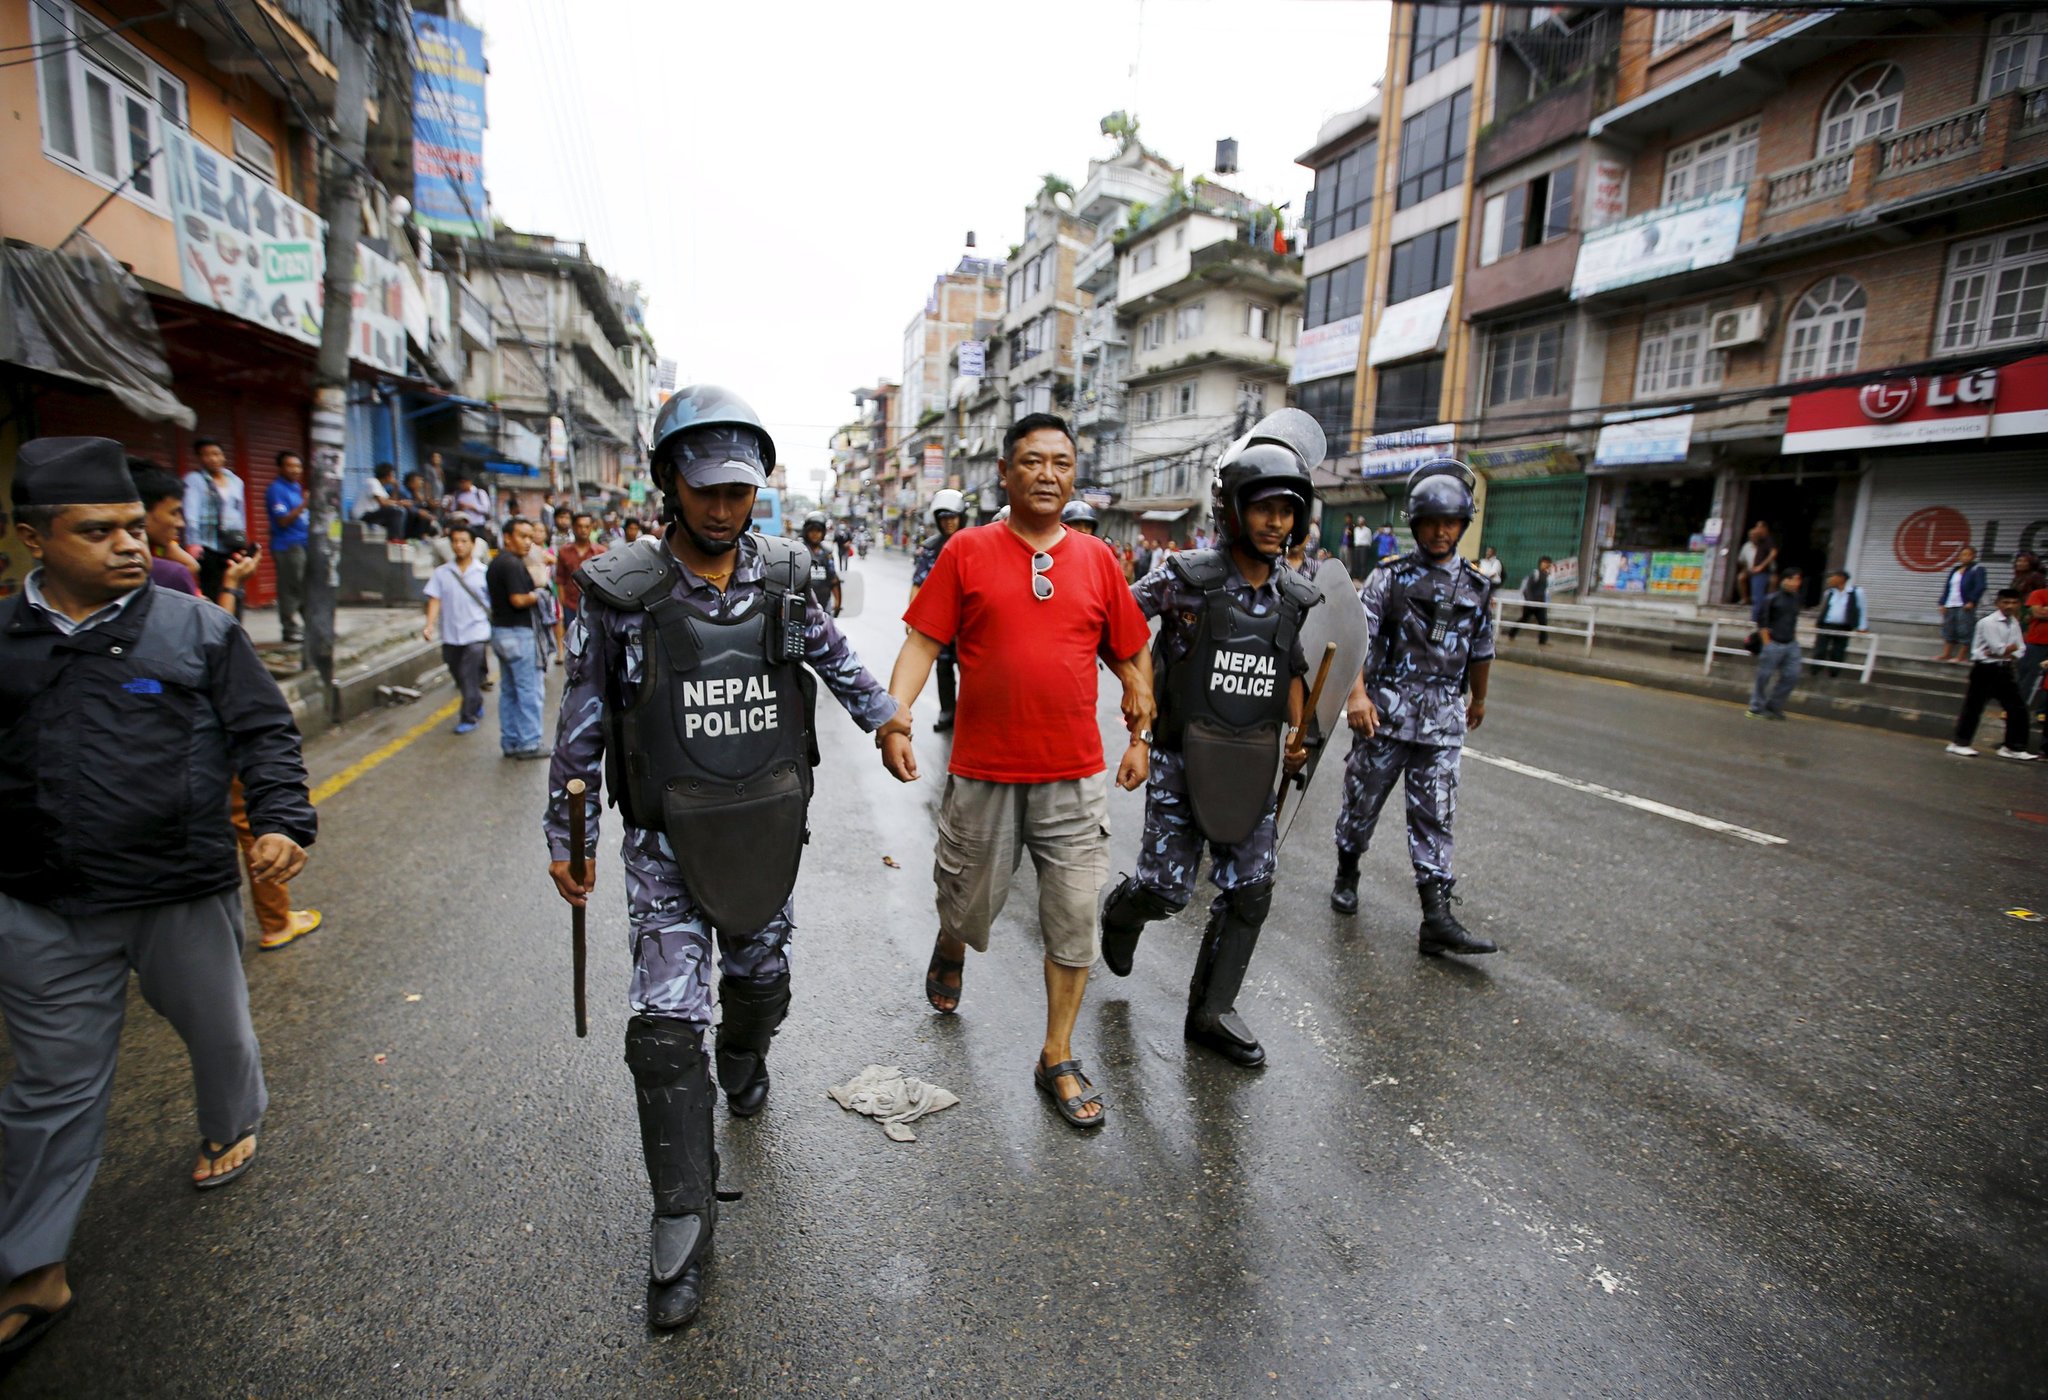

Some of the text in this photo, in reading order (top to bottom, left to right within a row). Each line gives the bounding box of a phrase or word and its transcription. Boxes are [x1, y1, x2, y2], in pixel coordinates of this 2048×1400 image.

[267, 246, 311, 280] Crazy
[1926, 368, 1997, 407] LG
[1214, 650, 1277, 675] NEPAL
[683, 674, 777, 707] NEPAL
[1209, 672, 1275, 697] POLICE
[685, 704, 779, 739] POLICE
